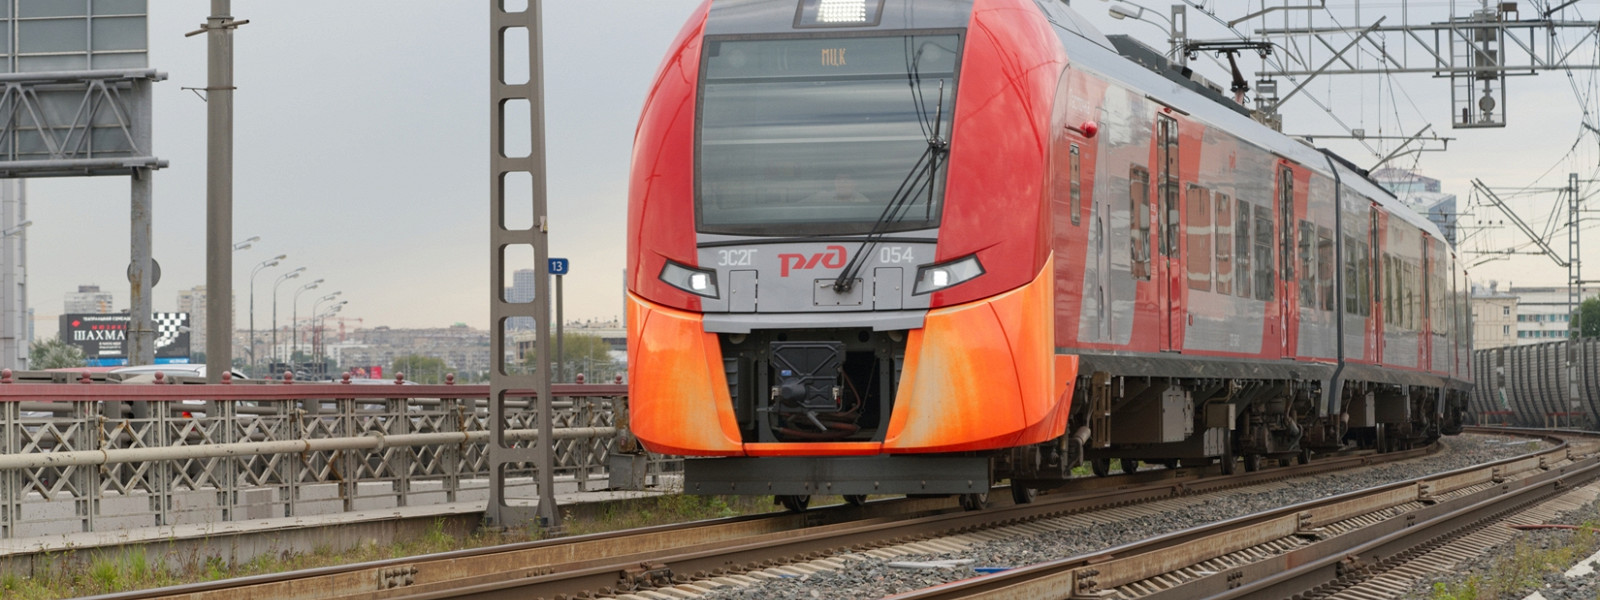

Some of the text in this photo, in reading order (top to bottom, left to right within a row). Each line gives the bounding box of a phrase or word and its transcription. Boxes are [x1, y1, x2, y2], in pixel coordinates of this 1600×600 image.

[822, 48, 847, 67] МЦК
[880, 247, 914, 263] 054
[552, 261, 563, 272] 13
[74, 330, 126, 340] ШАХМА
